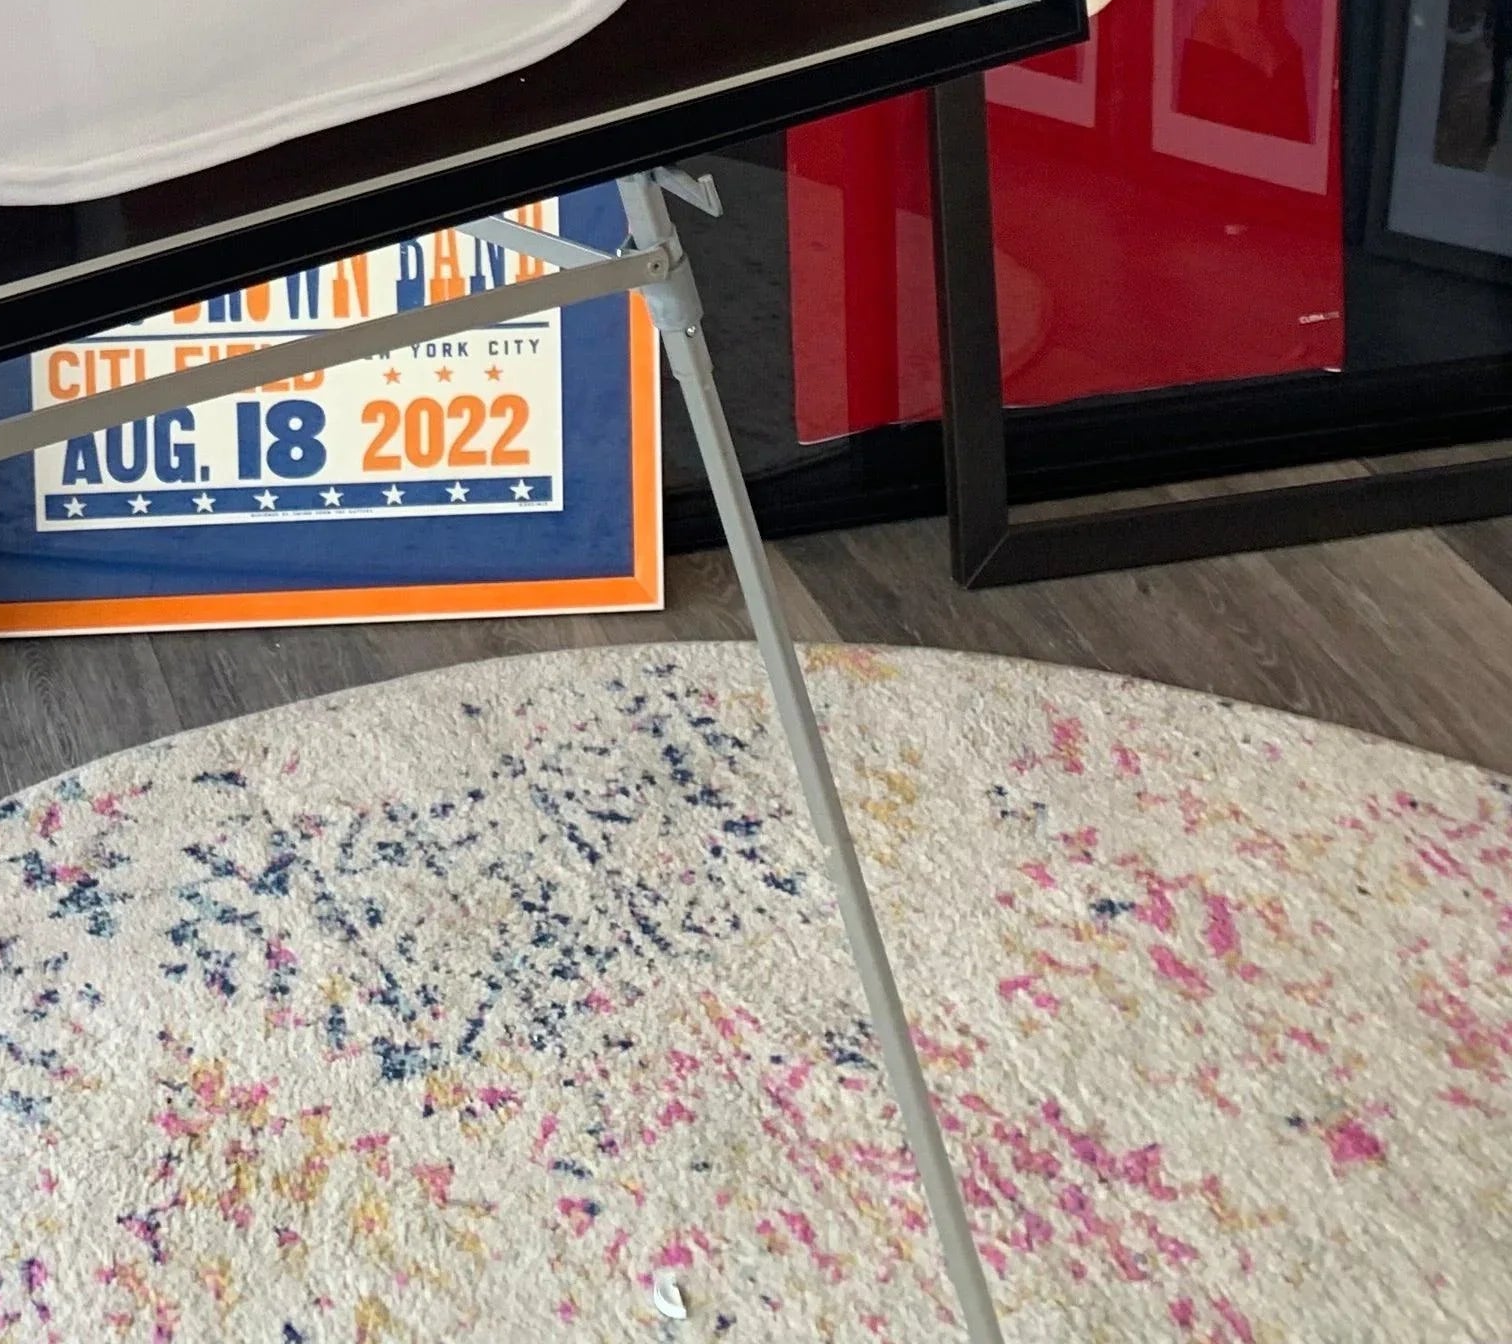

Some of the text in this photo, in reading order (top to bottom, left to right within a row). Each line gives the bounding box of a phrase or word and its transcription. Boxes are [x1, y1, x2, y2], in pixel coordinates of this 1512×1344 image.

[410, 342, 470, 359] YORK
[488, 339, 540, 356] CITY
[62, 394, 531, 485] AUG. 18 2022
